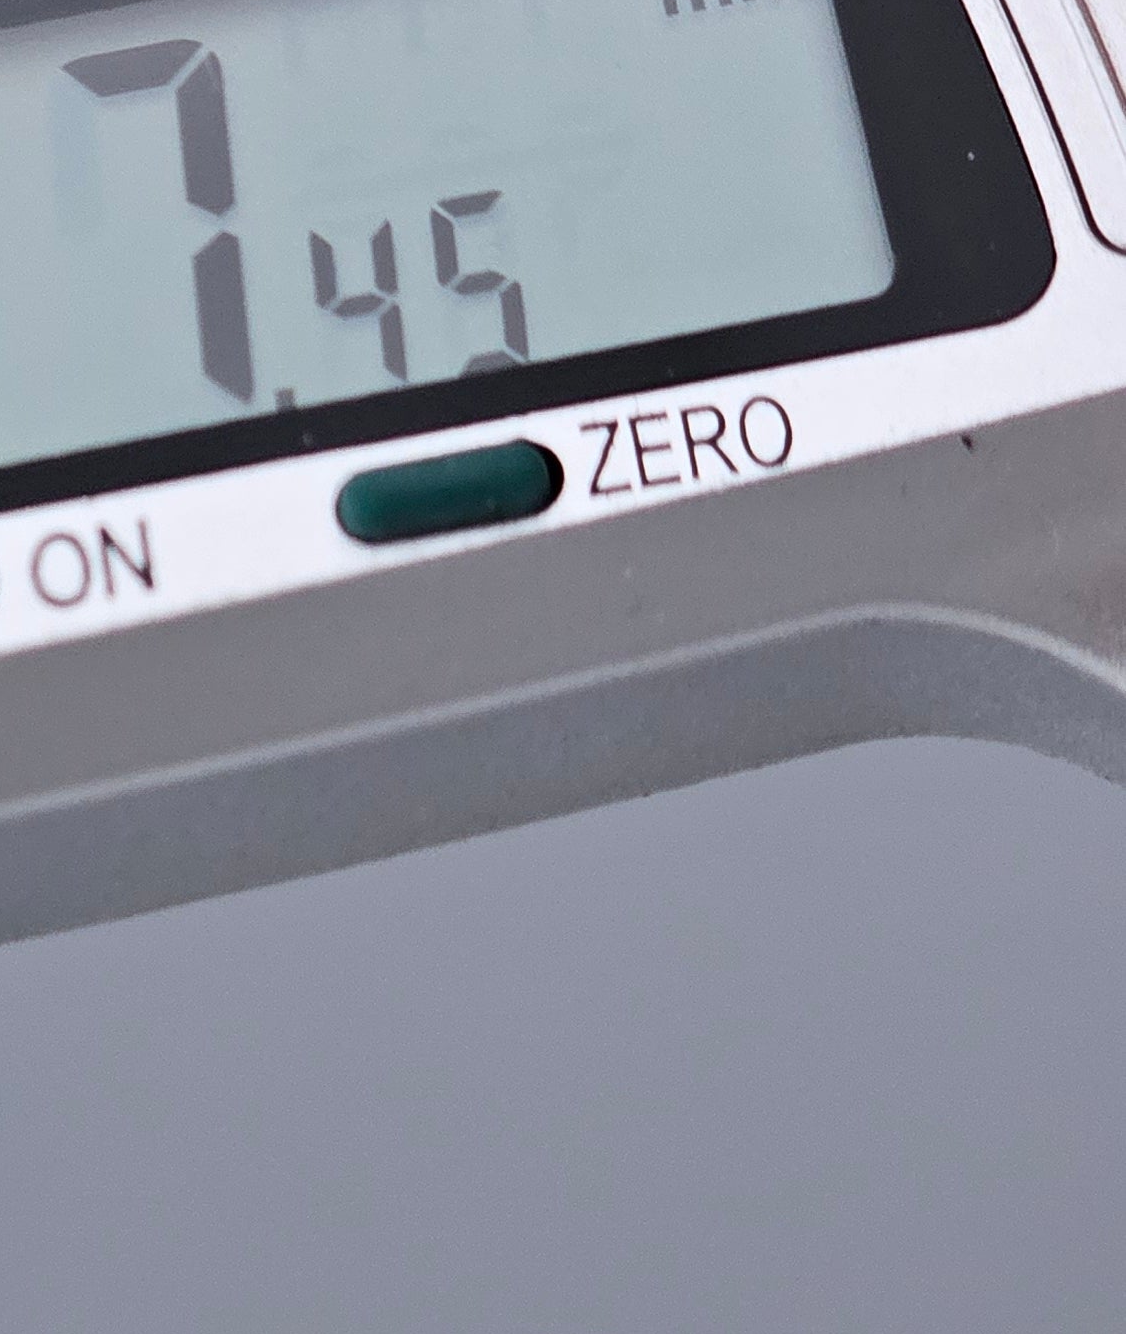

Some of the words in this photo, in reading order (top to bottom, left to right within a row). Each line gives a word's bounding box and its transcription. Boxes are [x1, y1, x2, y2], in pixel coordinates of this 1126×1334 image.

[61, 38, 530, 413] 7.45
[579, 396, 794, 496] ZERO
[30, 517, 157, 608] ON
